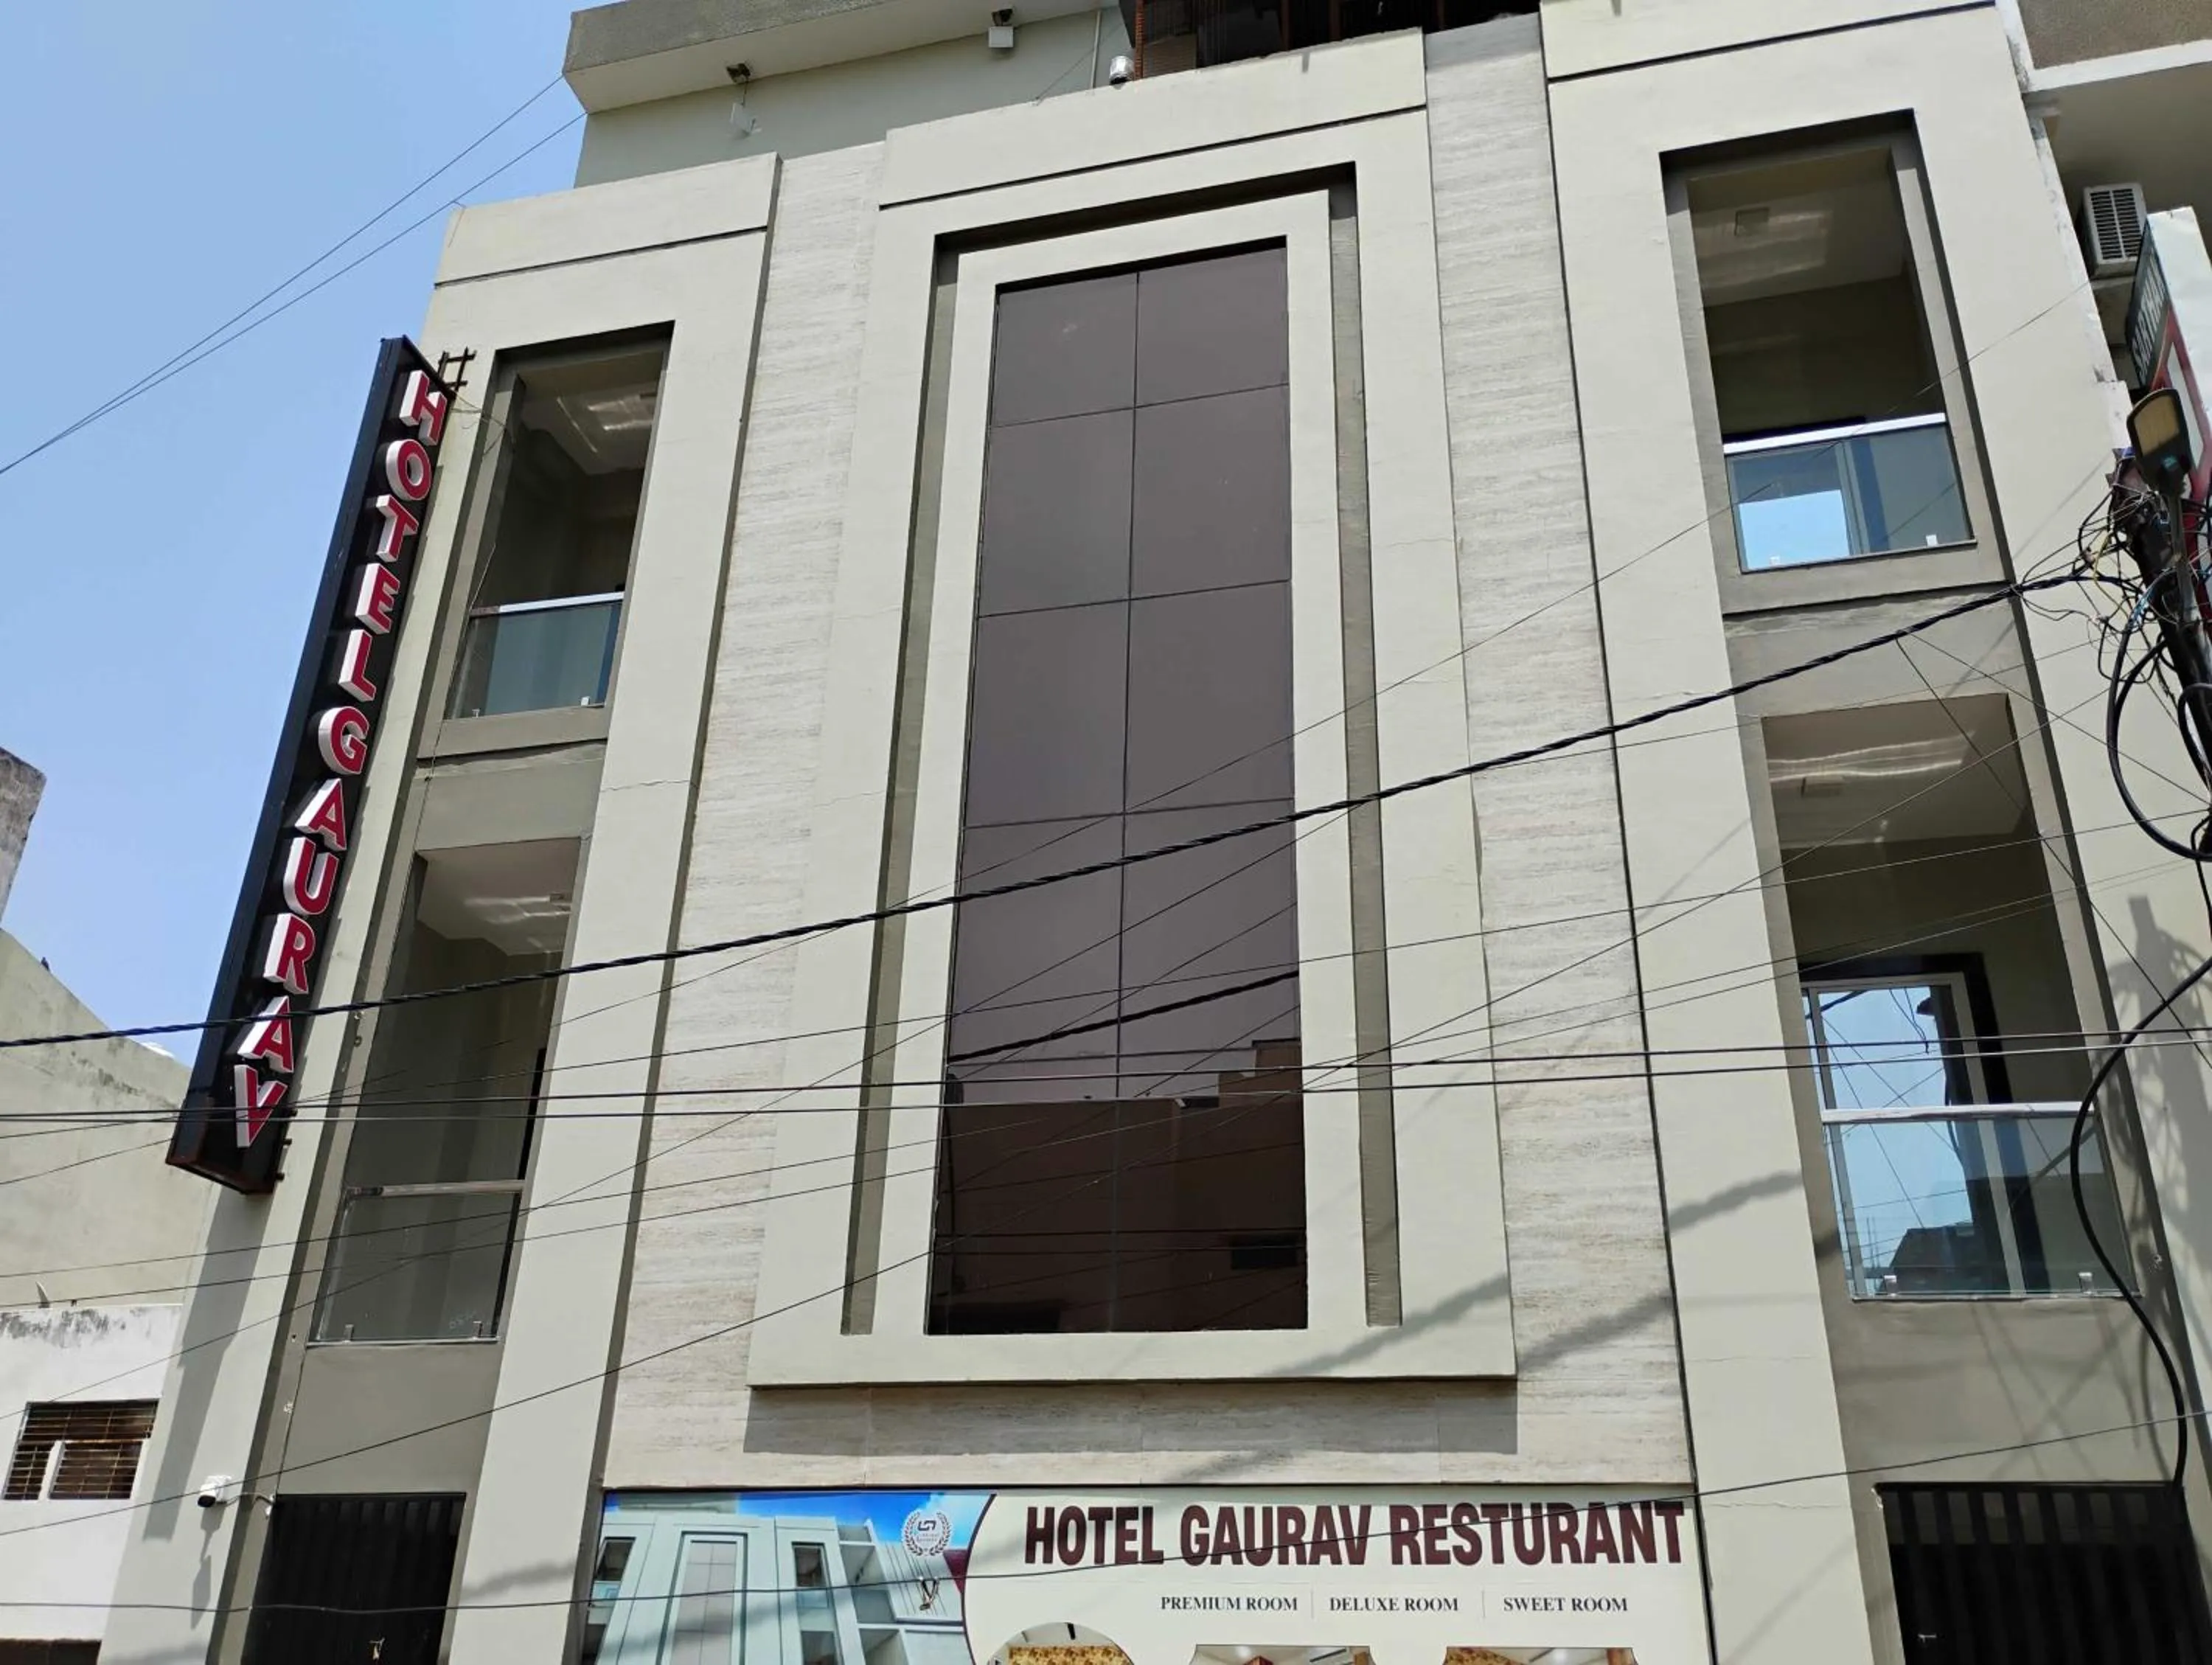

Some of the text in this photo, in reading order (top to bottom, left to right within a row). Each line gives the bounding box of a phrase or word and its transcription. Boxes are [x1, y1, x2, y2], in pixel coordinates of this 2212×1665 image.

[234, 369, 448, 1148] HOTEL GAURAV
[1024, 1501, 1685, 1566] HOTEL GAURAV RESTURANT
[1161, 1596, 1298, 1613] PREMIUM ROOM
[1329, 1597, 1459, 1613] DELUXE ROOM
[1503, 1597, 1629, 1613] SWEET ROOM
